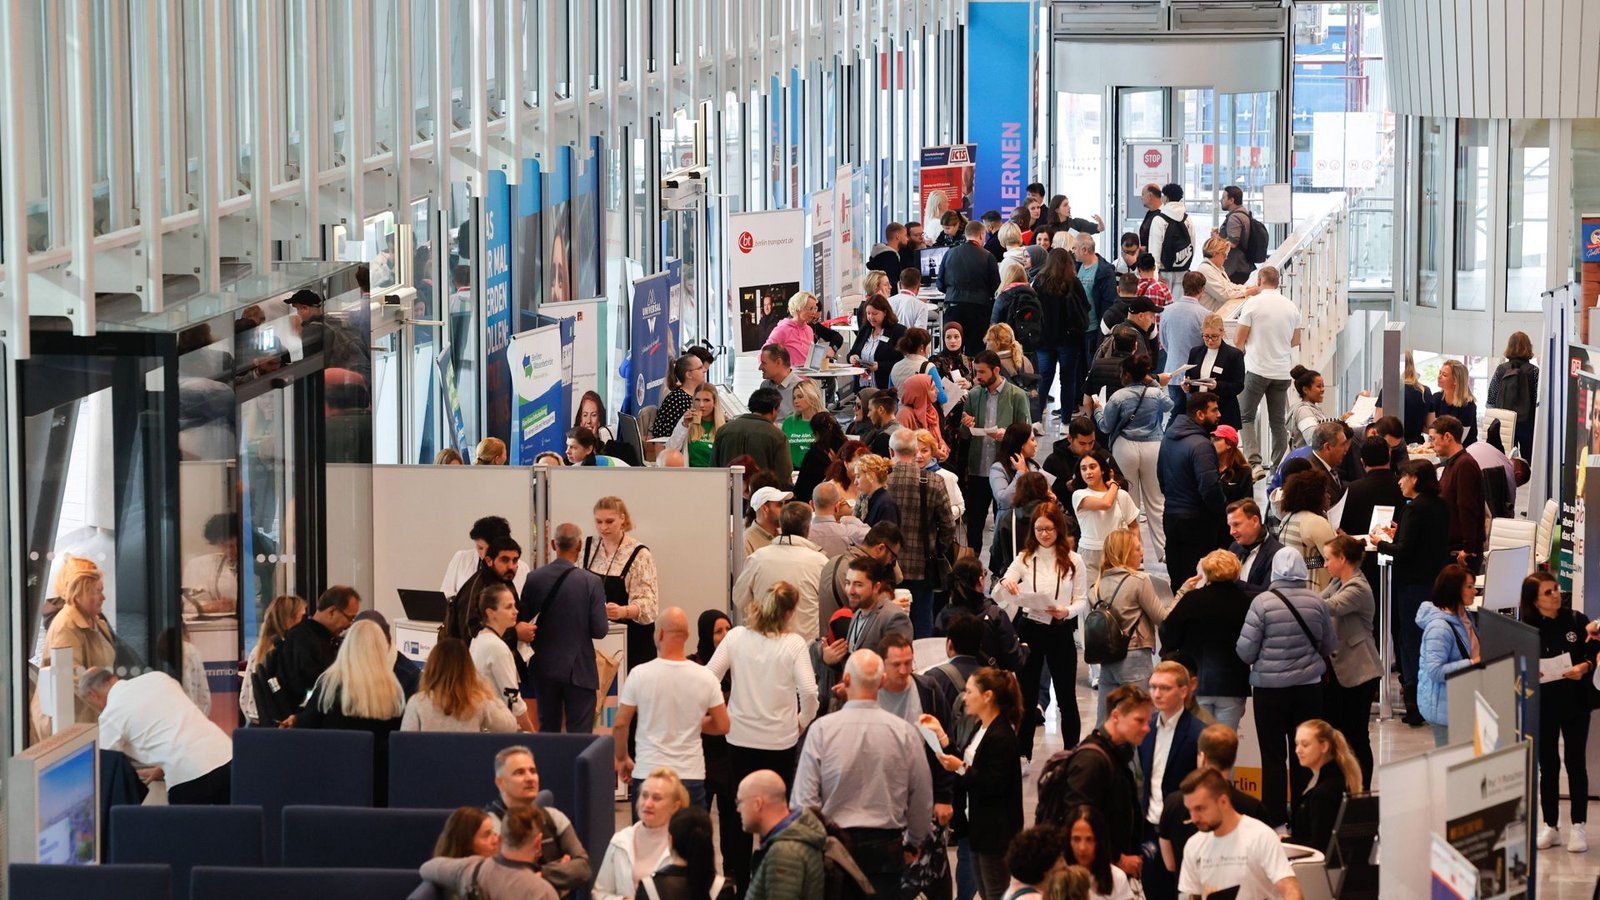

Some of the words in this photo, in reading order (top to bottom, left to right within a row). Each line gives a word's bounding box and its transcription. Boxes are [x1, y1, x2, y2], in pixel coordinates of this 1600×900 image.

[1144, 154, 1161, 164] STOP
[493, 243, 508, 276] MAL
[1175, 243, 1193, 263] NIKE
[642, 303, 661, 317] UNIVERSAL
[1561, 530, 1571, 542] das
[1233, 777, 1257, 792] rlin
